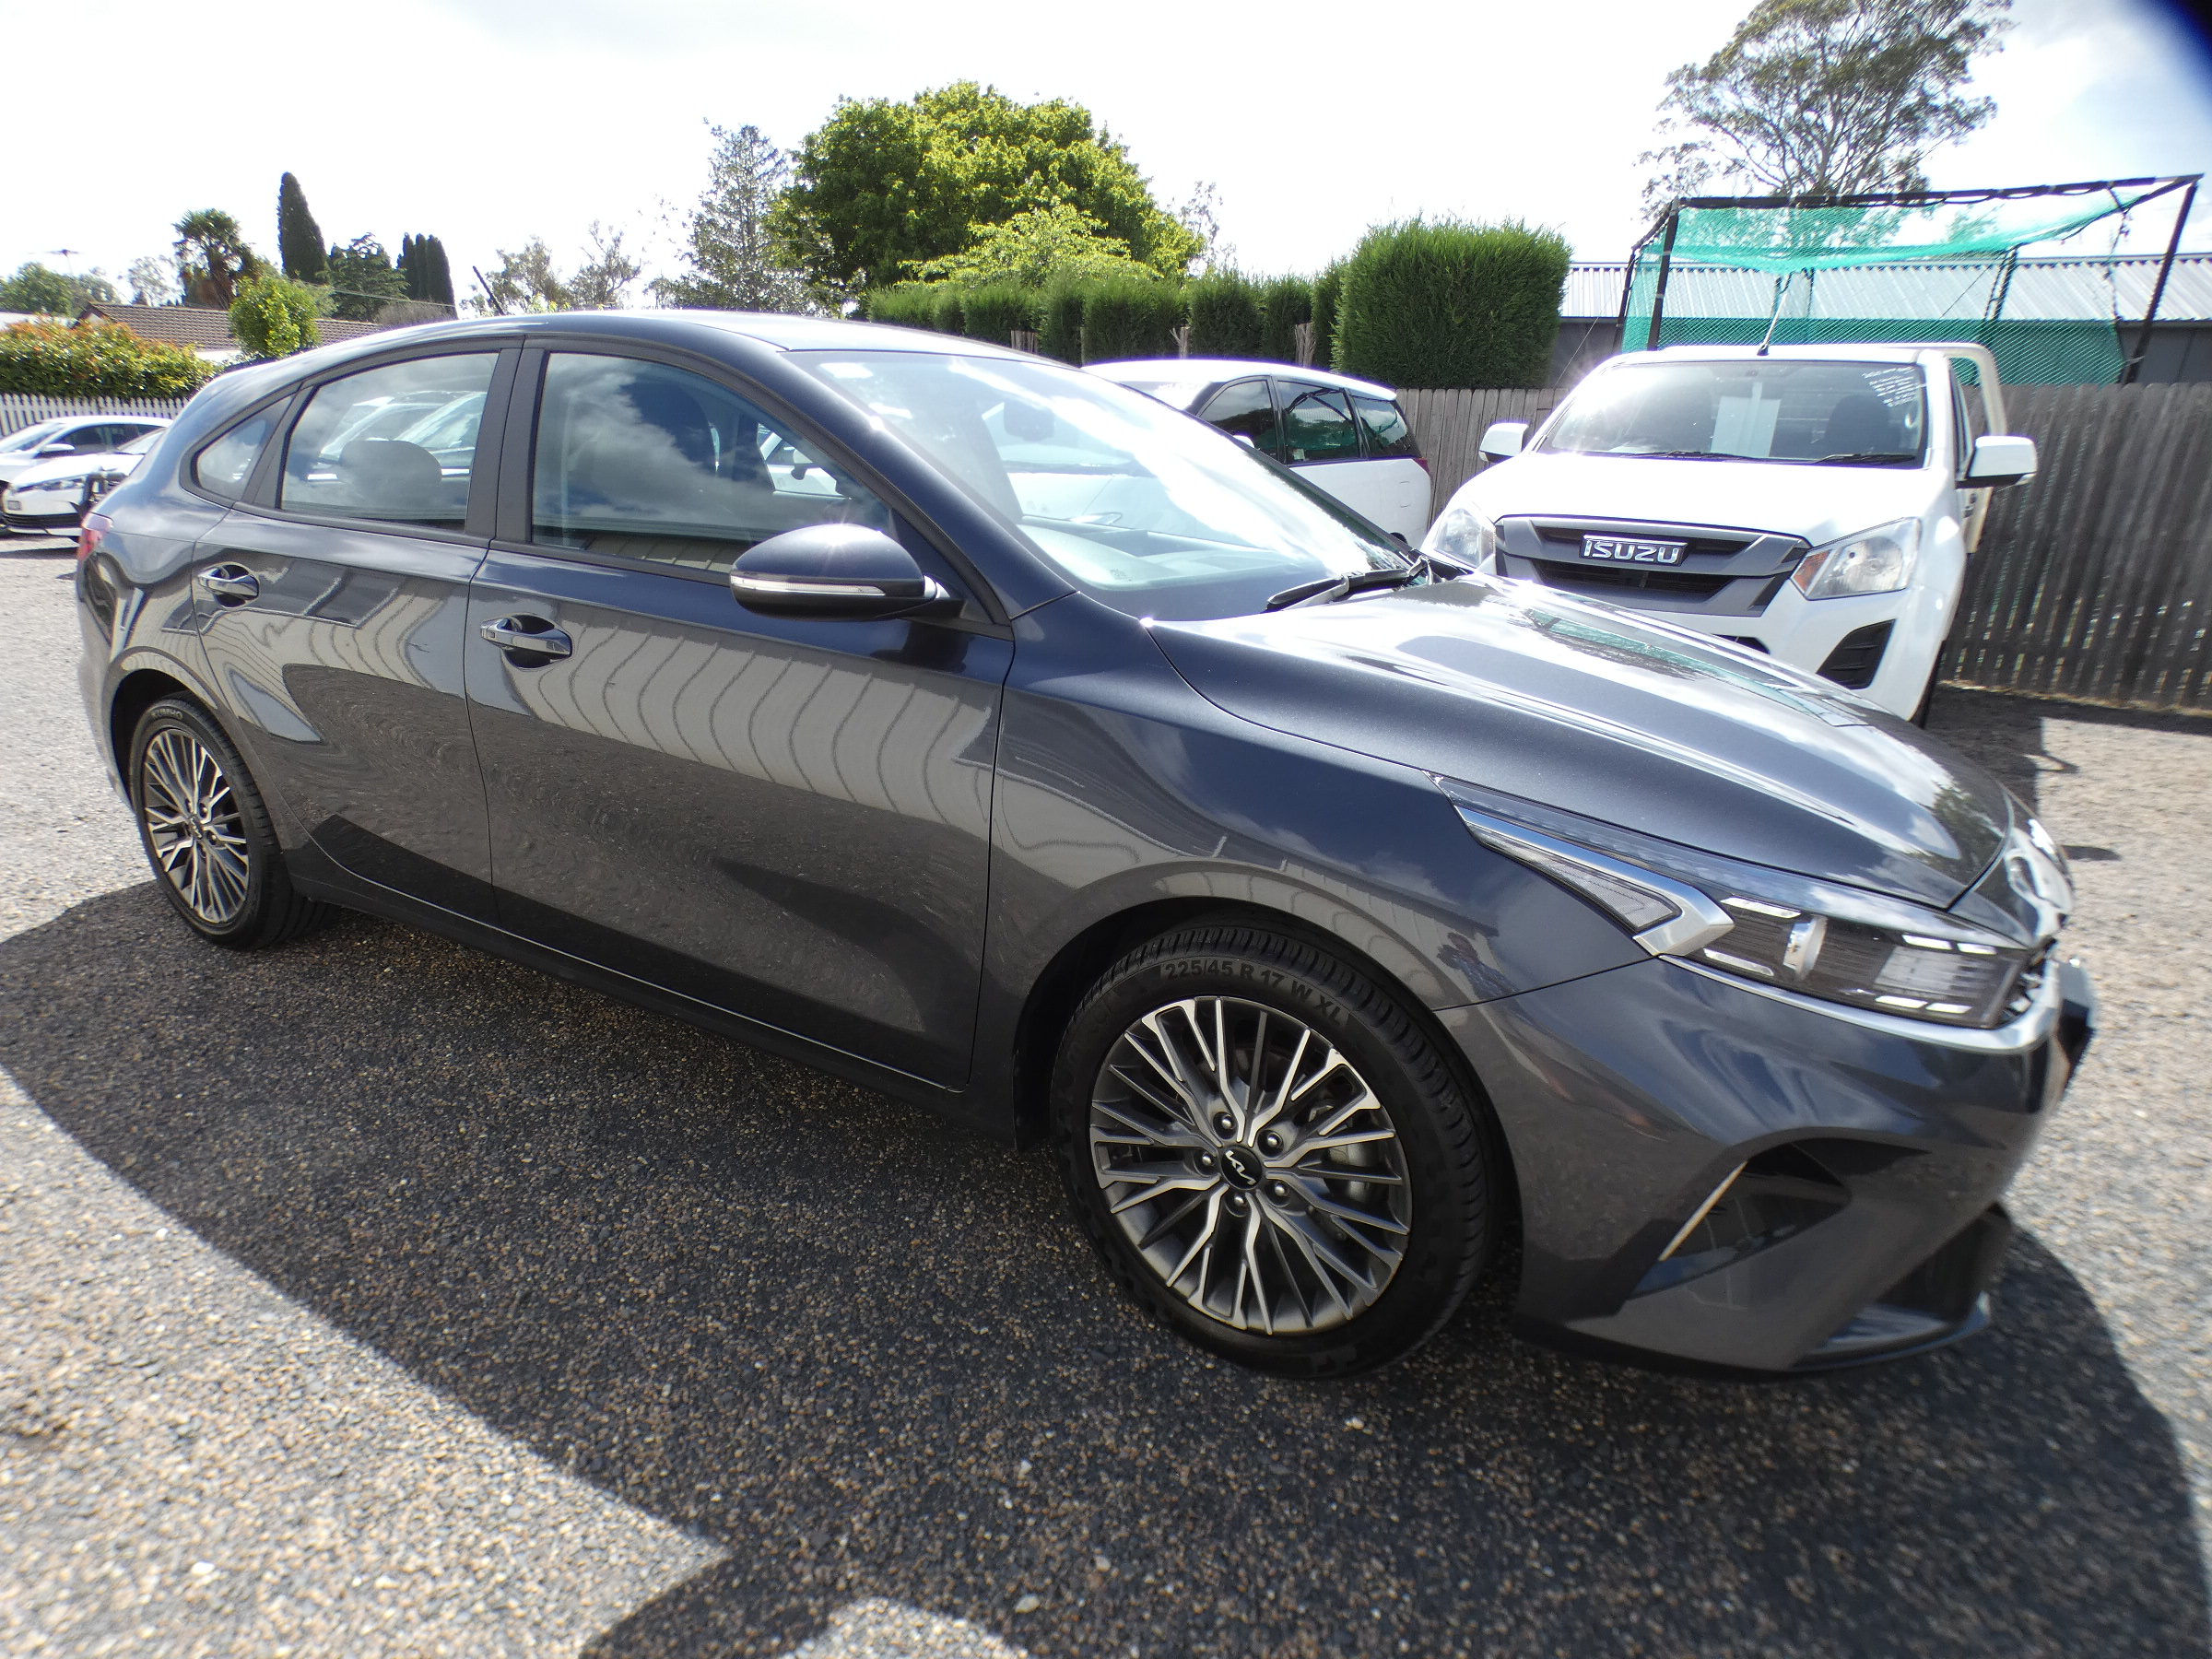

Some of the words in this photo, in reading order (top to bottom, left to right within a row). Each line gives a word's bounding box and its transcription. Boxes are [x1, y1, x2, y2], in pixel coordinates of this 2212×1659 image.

[1583, 539, 1679, 563] ISUZU
[1164, 959, 1233, 981] 225/45
[1240, 964, 1254, 981] R
[1260, 968, 1284, 988] 17
[1290, 983, 1312, 1002] W
[1312, 999, 1343, 1026] XL
